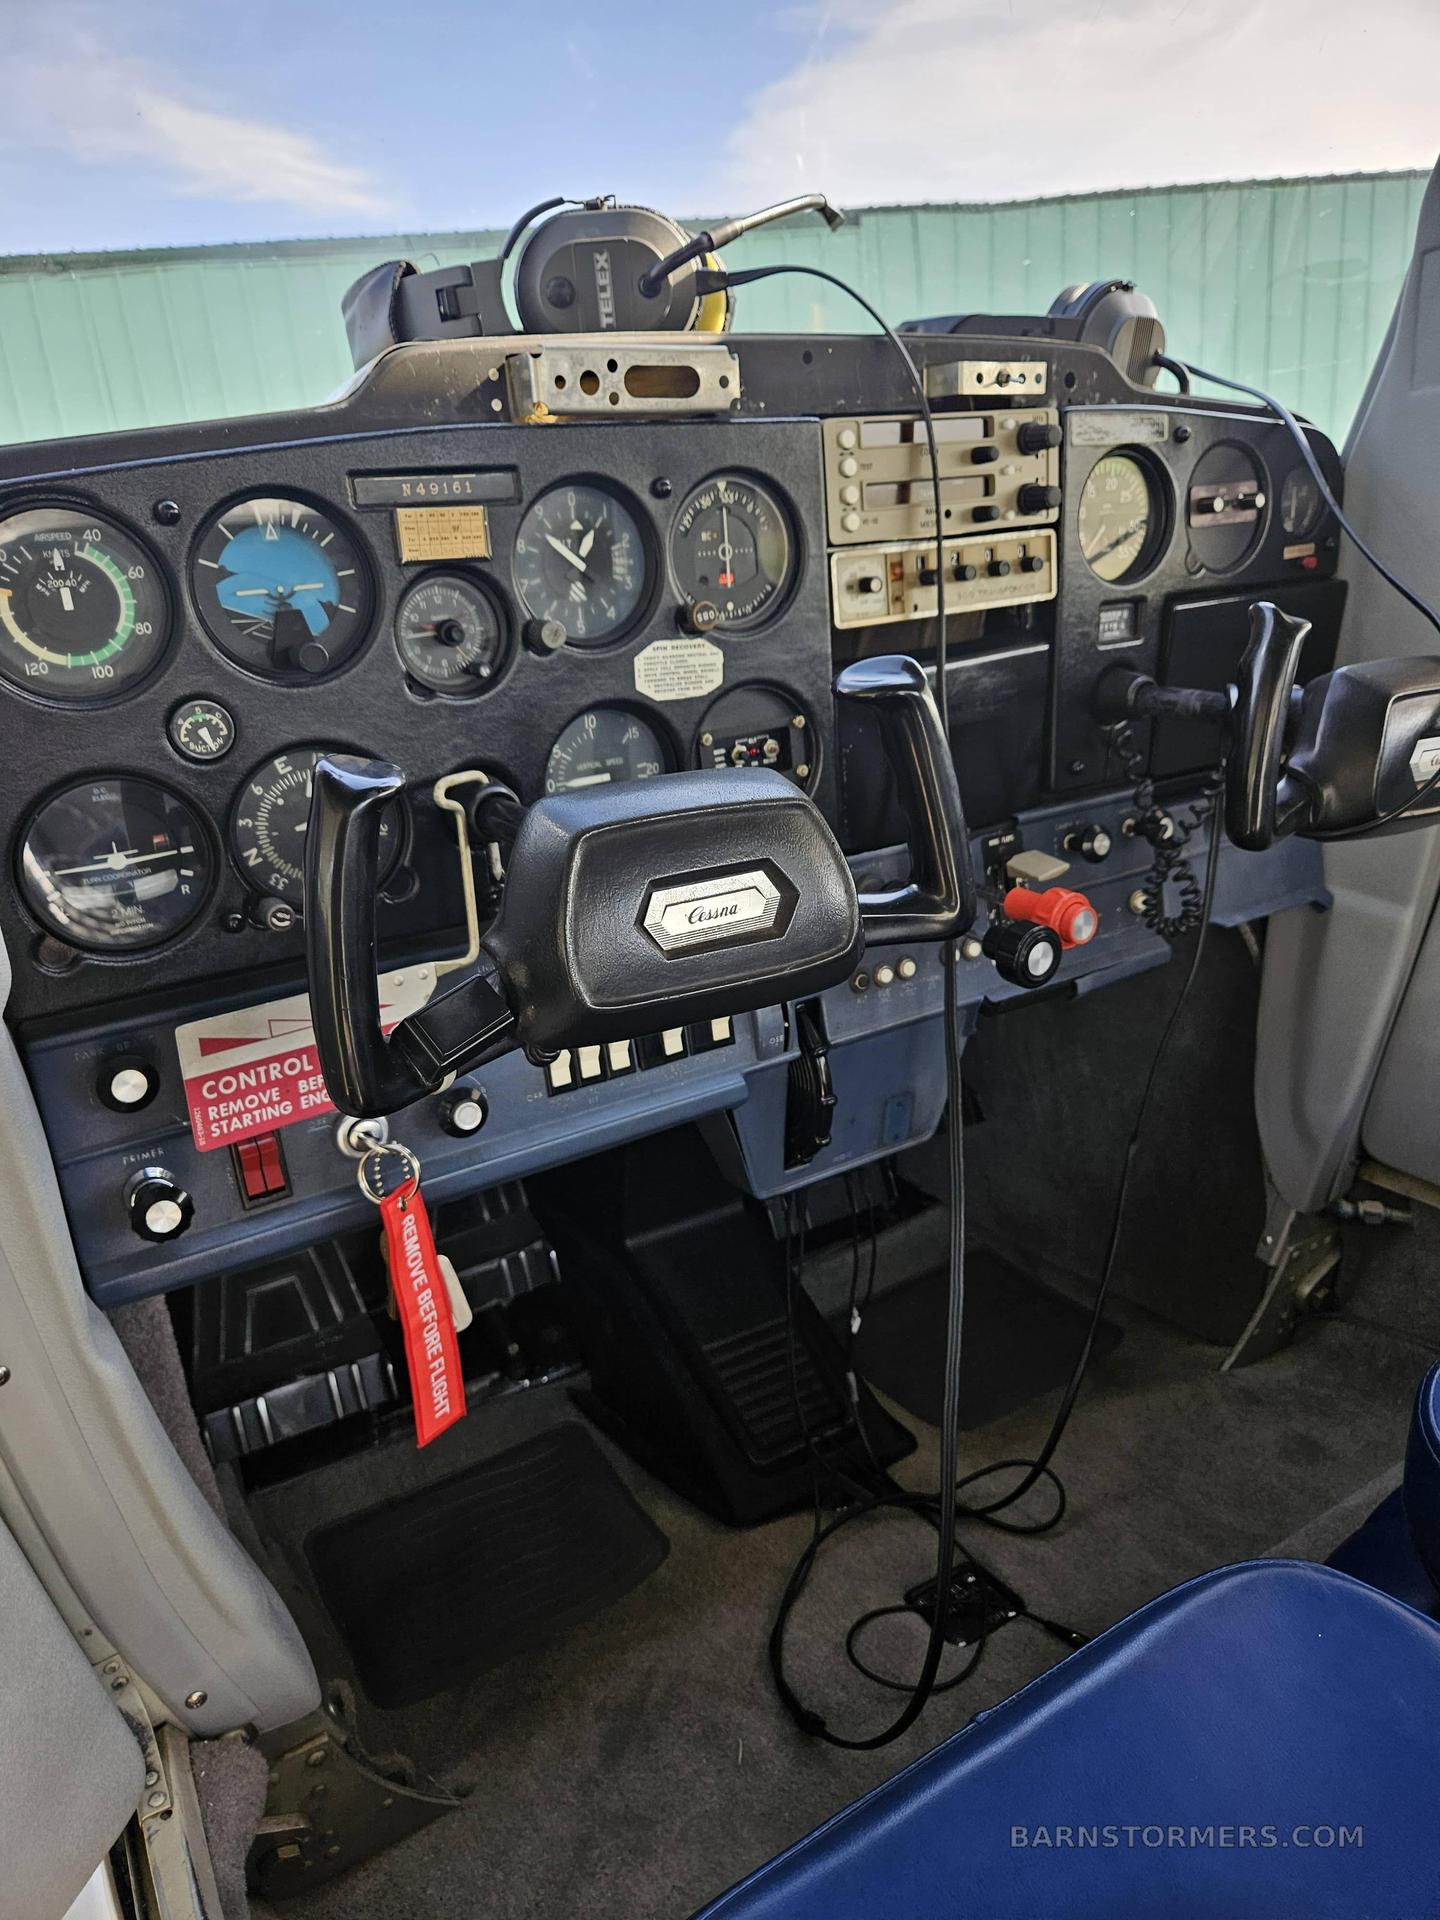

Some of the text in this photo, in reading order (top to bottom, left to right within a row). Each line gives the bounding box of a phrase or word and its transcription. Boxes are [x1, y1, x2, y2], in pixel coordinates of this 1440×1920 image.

[593, 248, 616, 329] TELEX
[402, 481, 472, 497] N49161
[567, 492, 576, 507] 0
[534, 505, 544, 520] 9
[34, 531, 72, 542] AIRSPEED
[82, 528, 102, 542] 40
[516, 538, 526, 554] 8
[127, 565, 145, 580] 60
[47, 579, 77, 588] 200 40
[135, 622, 152, 635] 80
[576, 619, 586, 634] 5
[24, 663, 49, 677] 120
[91, 665, 114, 679] 100
[584, 714, 597, 729] 10
[628, 727, 640, 740] 15
[189, 737, 224, 752] SUCTON
[552, 744, 561, 759] 5
[273, 755, 293, 776] E
[646, 762, 660, 775] 20
[250, 783, 264, 796] 6
[546, 779, 556, 793] 0
[238, 818, 253, 828] 3
[242, 847, 264, 867] N
[268, 872, 290, 891] 33
[181, 884, 191, 895] R
[687, 904, 739, 925] Cessna
[202, 1053, 314, 1100] CONTROL
[207, 1074, 326, 1121] REMOVE BEF
[210, 1101, 293, 1137] STARTING
[301, 1090, 331, 1109] ENG
[122, 1147, 165, 1165] PRIMER
[401, 1213, 450, 1419] REMOVE BEFORE FLIGHT
